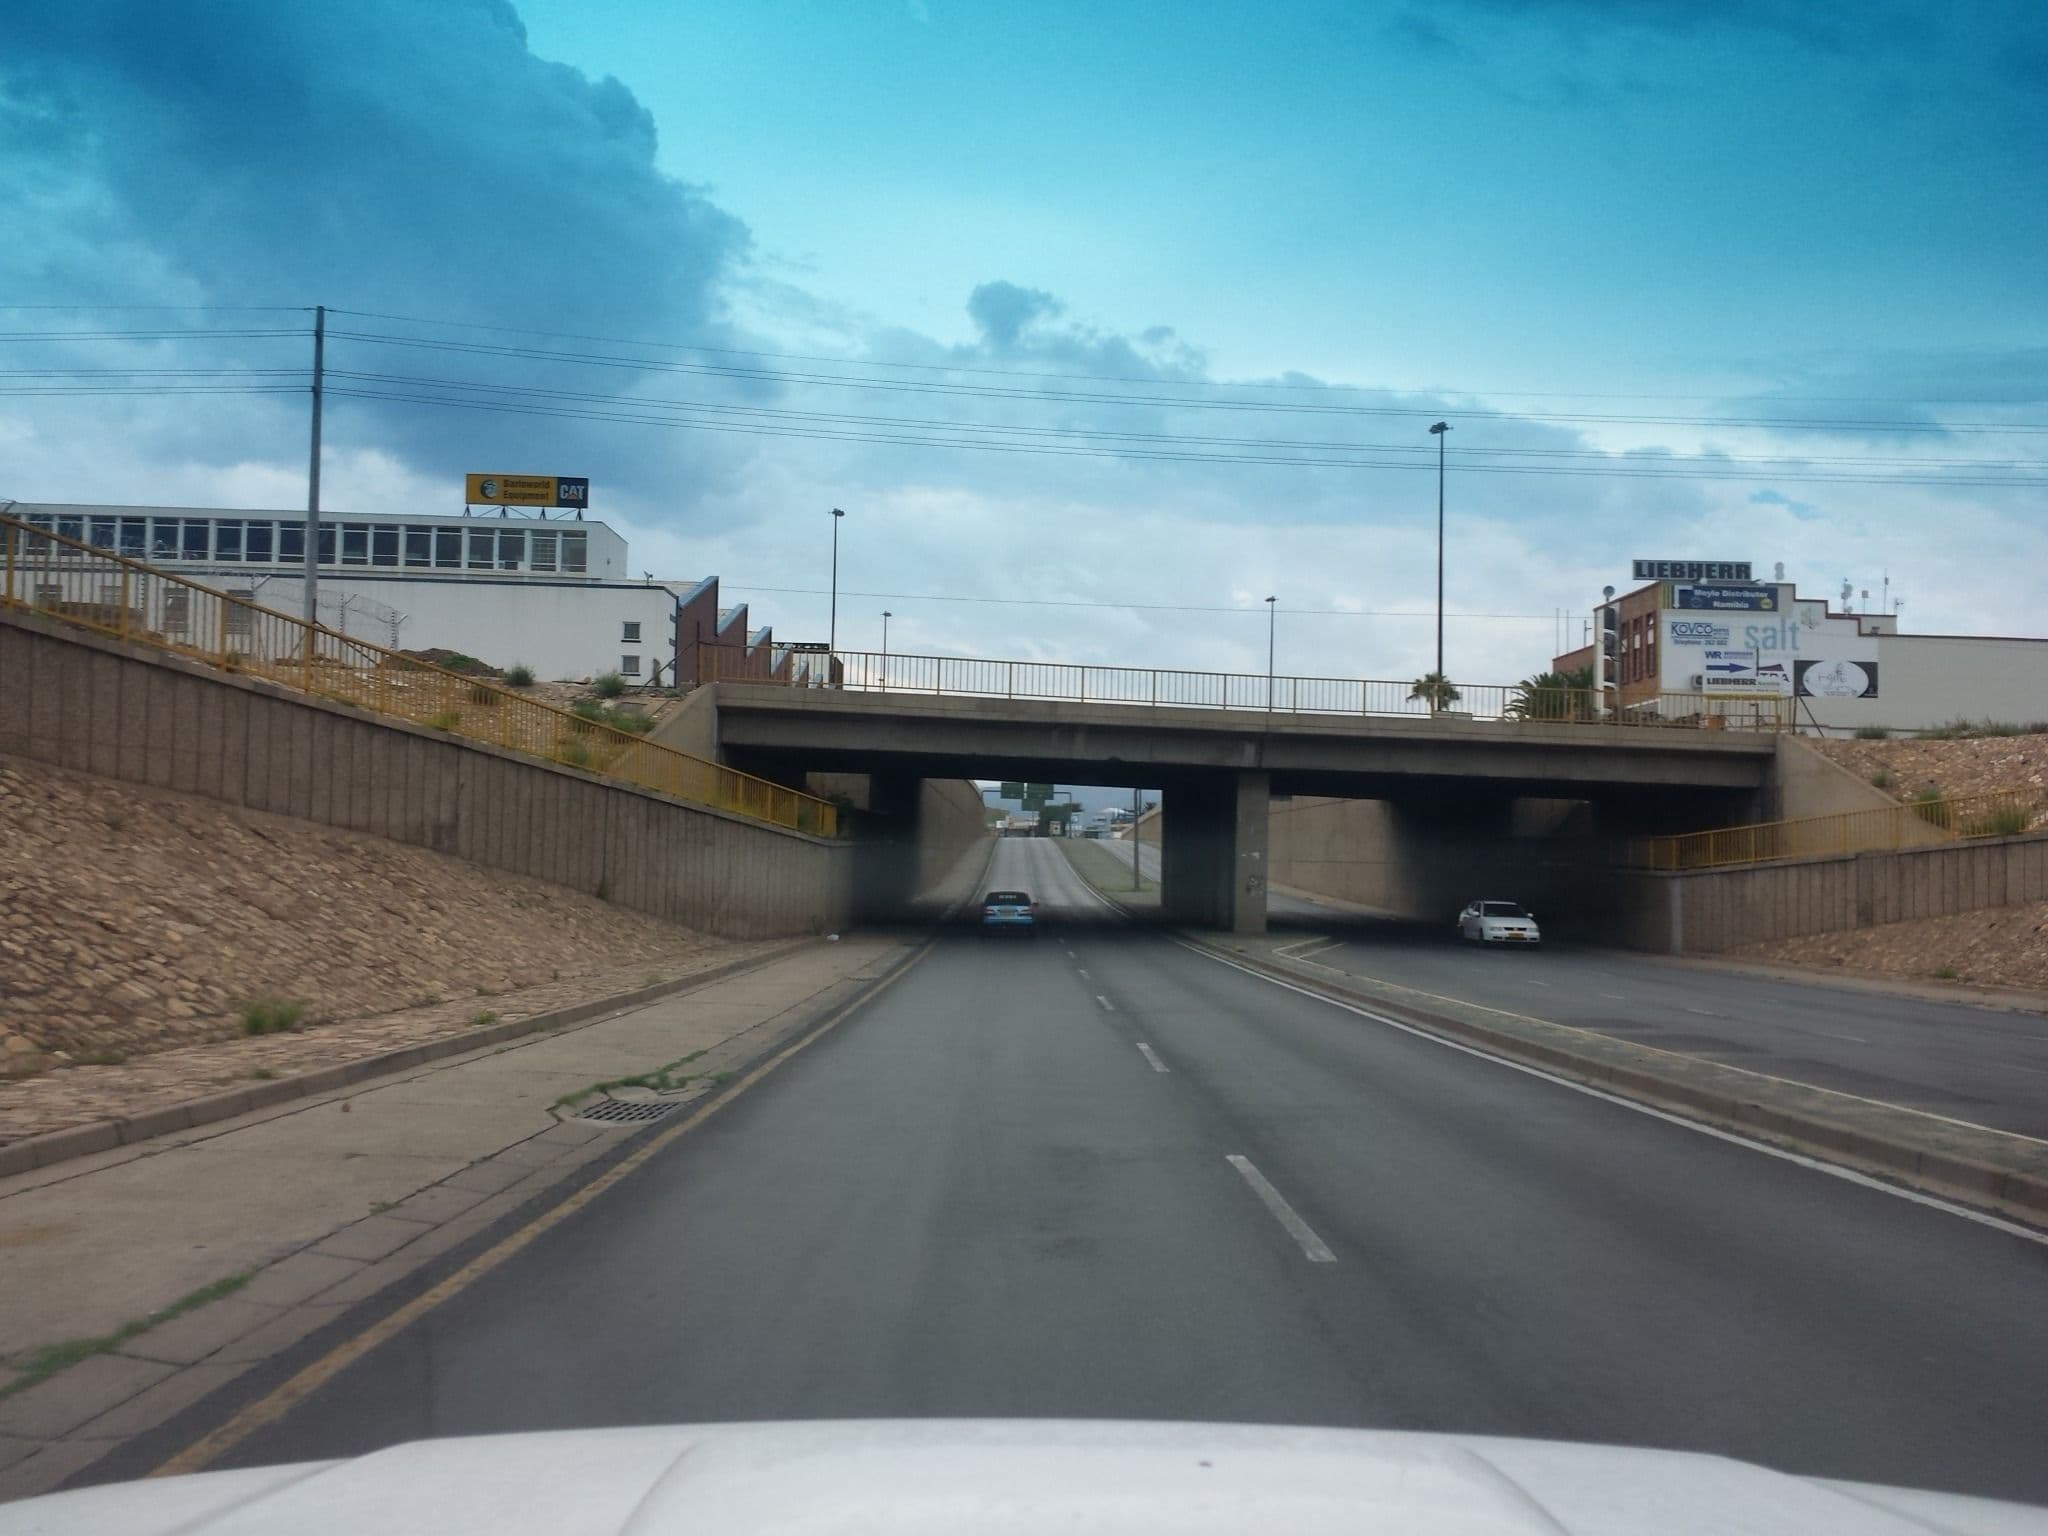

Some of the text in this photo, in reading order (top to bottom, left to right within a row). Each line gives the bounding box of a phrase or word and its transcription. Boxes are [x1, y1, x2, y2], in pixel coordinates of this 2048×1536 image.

[560, 484, 584, 501] CAT
[1635, 561, 1751, 579] LIEBHERR
[1722, 590, 1768, 598] Distributor
[1671, 622, 1712, 636] KOVCO
[1745, 618, 1800, 650] salt
[1705, 651, 1721, 659] WR
[1707, 677, 1757, 686] LIEBHERR
